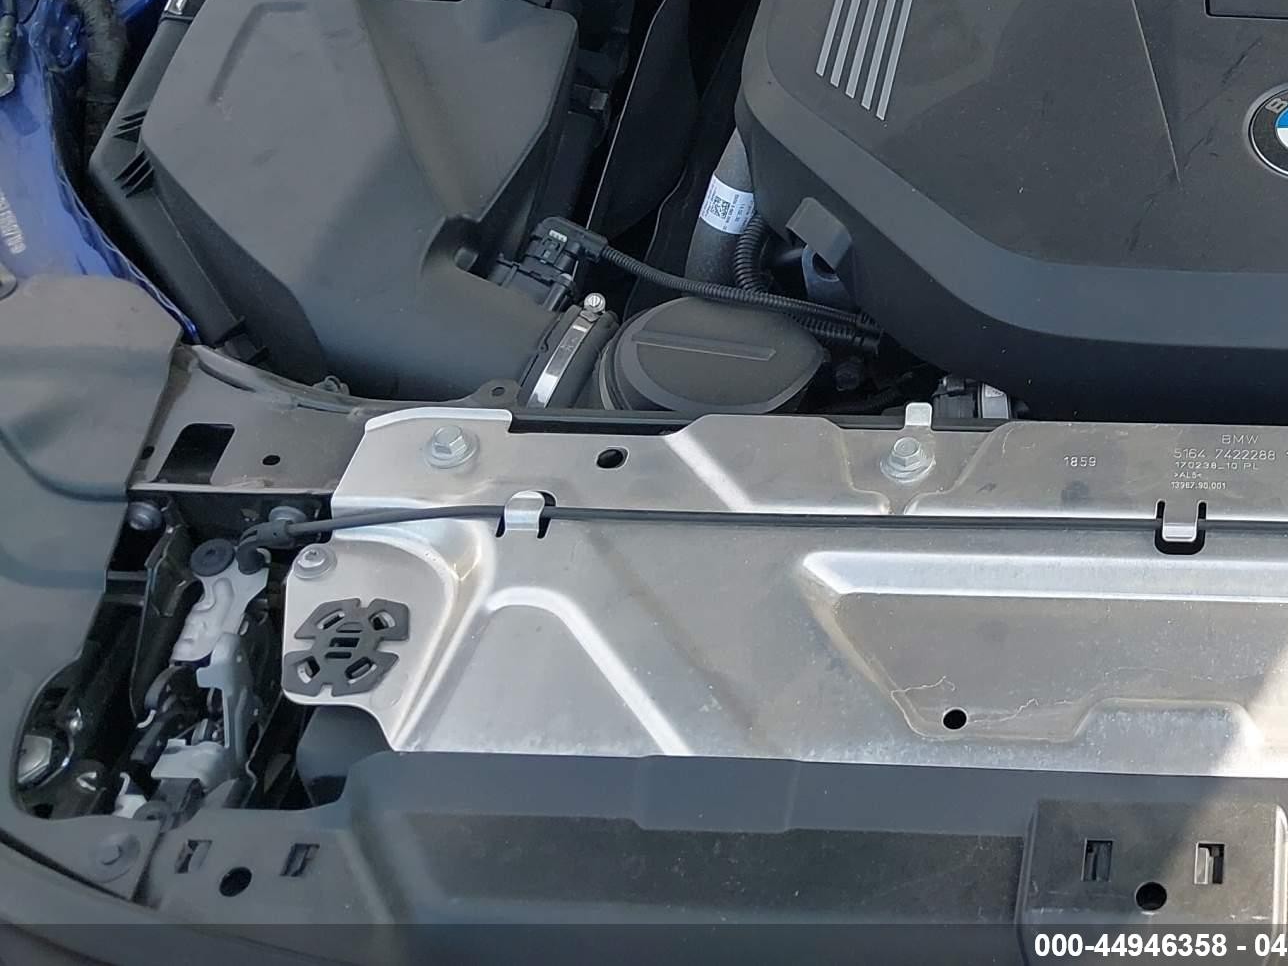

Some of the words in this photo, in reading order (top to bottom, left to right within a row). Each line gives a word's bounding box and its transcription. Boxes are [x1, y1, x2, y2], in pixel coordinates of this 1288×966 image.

[1221, 434, 1259, 444] BMW
[1173, 448, 1206, 459] 5164
[1215, 449, 1276, 460] 7422288
[1063, 456, 1097, 467] 1859
